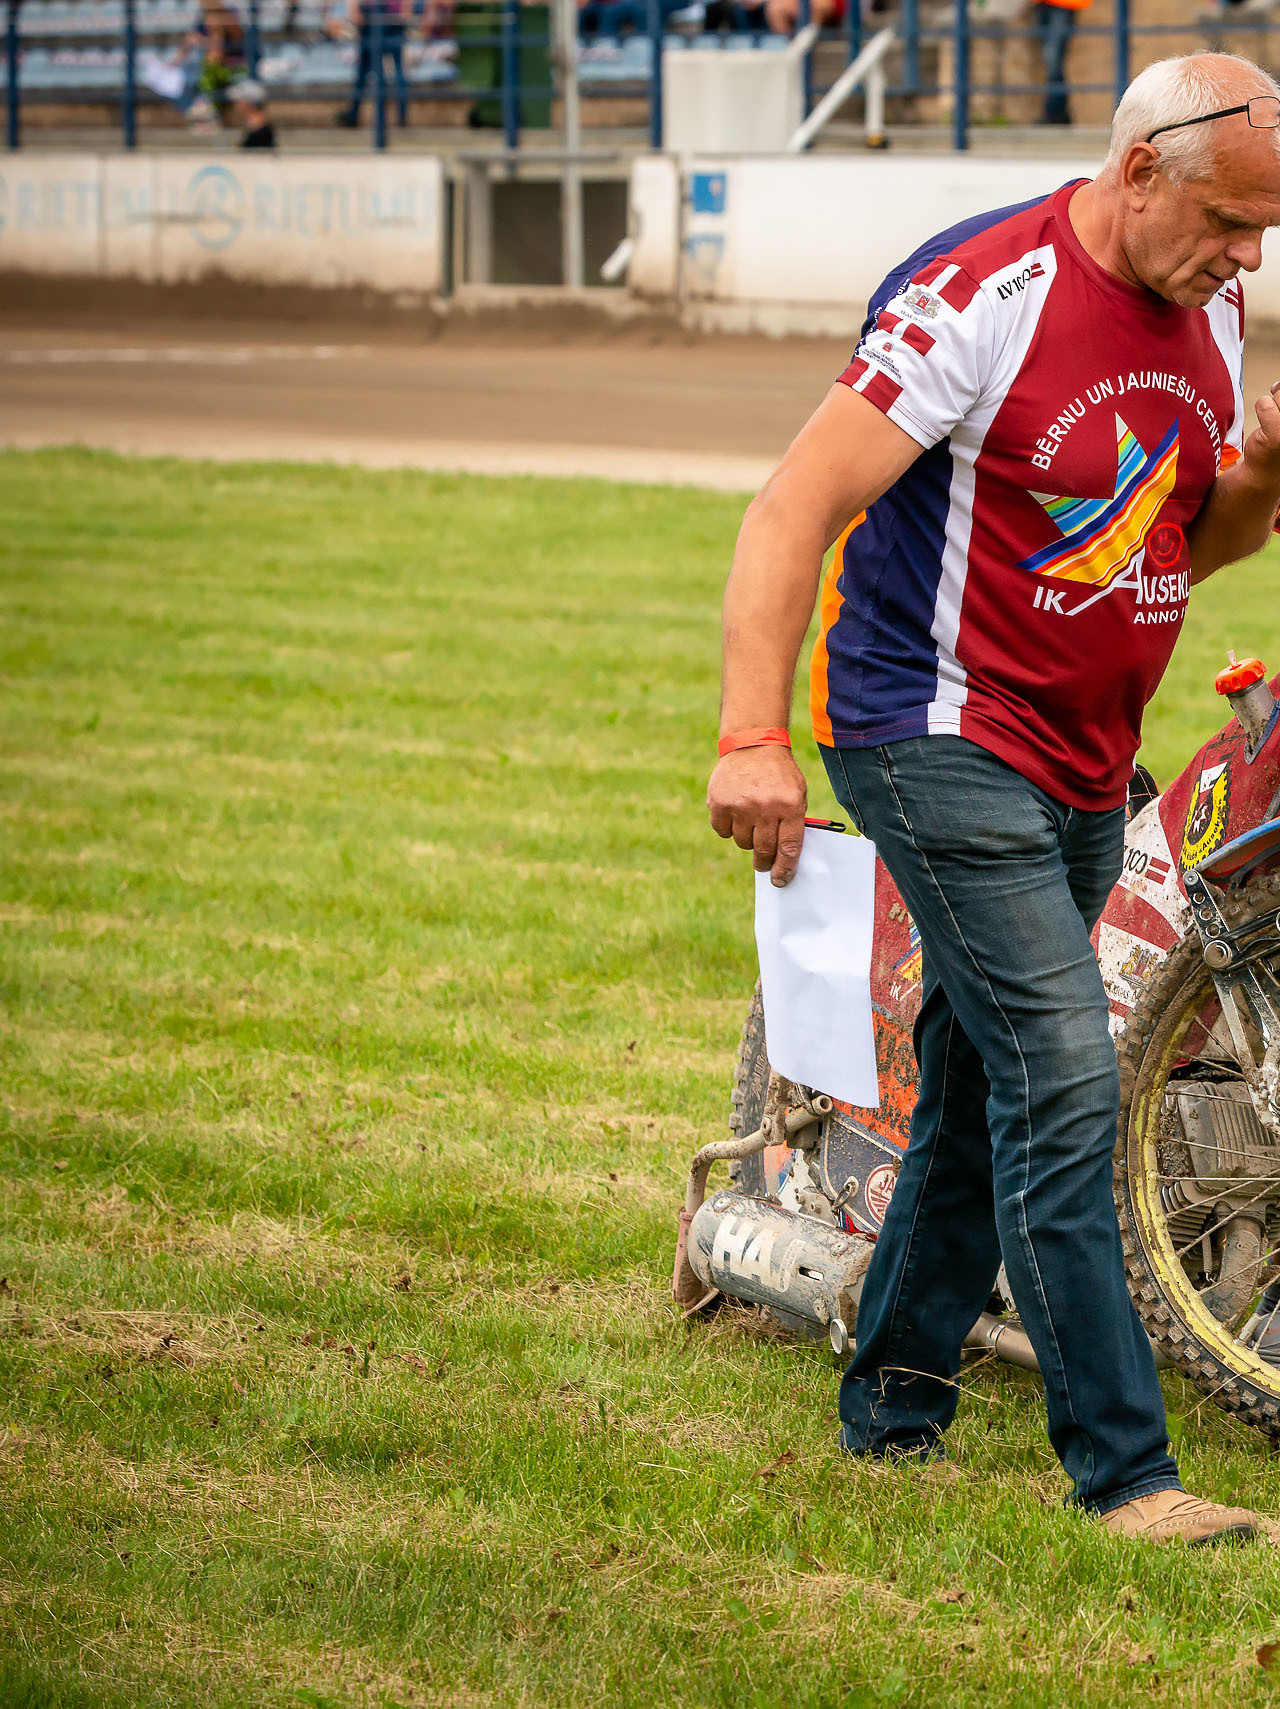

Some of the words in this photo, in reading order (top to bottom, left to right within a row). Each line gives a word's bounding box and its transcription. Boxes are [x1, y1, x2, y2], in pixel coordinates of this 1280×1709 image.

[1031, 398, 1086, 470] BĒRNU
[1086, 378, 1114, 405] UN
[1117, 371, 1196, 404] JAUNIEŠU
[1032, 585, 1067, 615] IK
[1112, 546, 1191, 605] AUSEKL
[1133, 609, 1178, 625] ANNO
